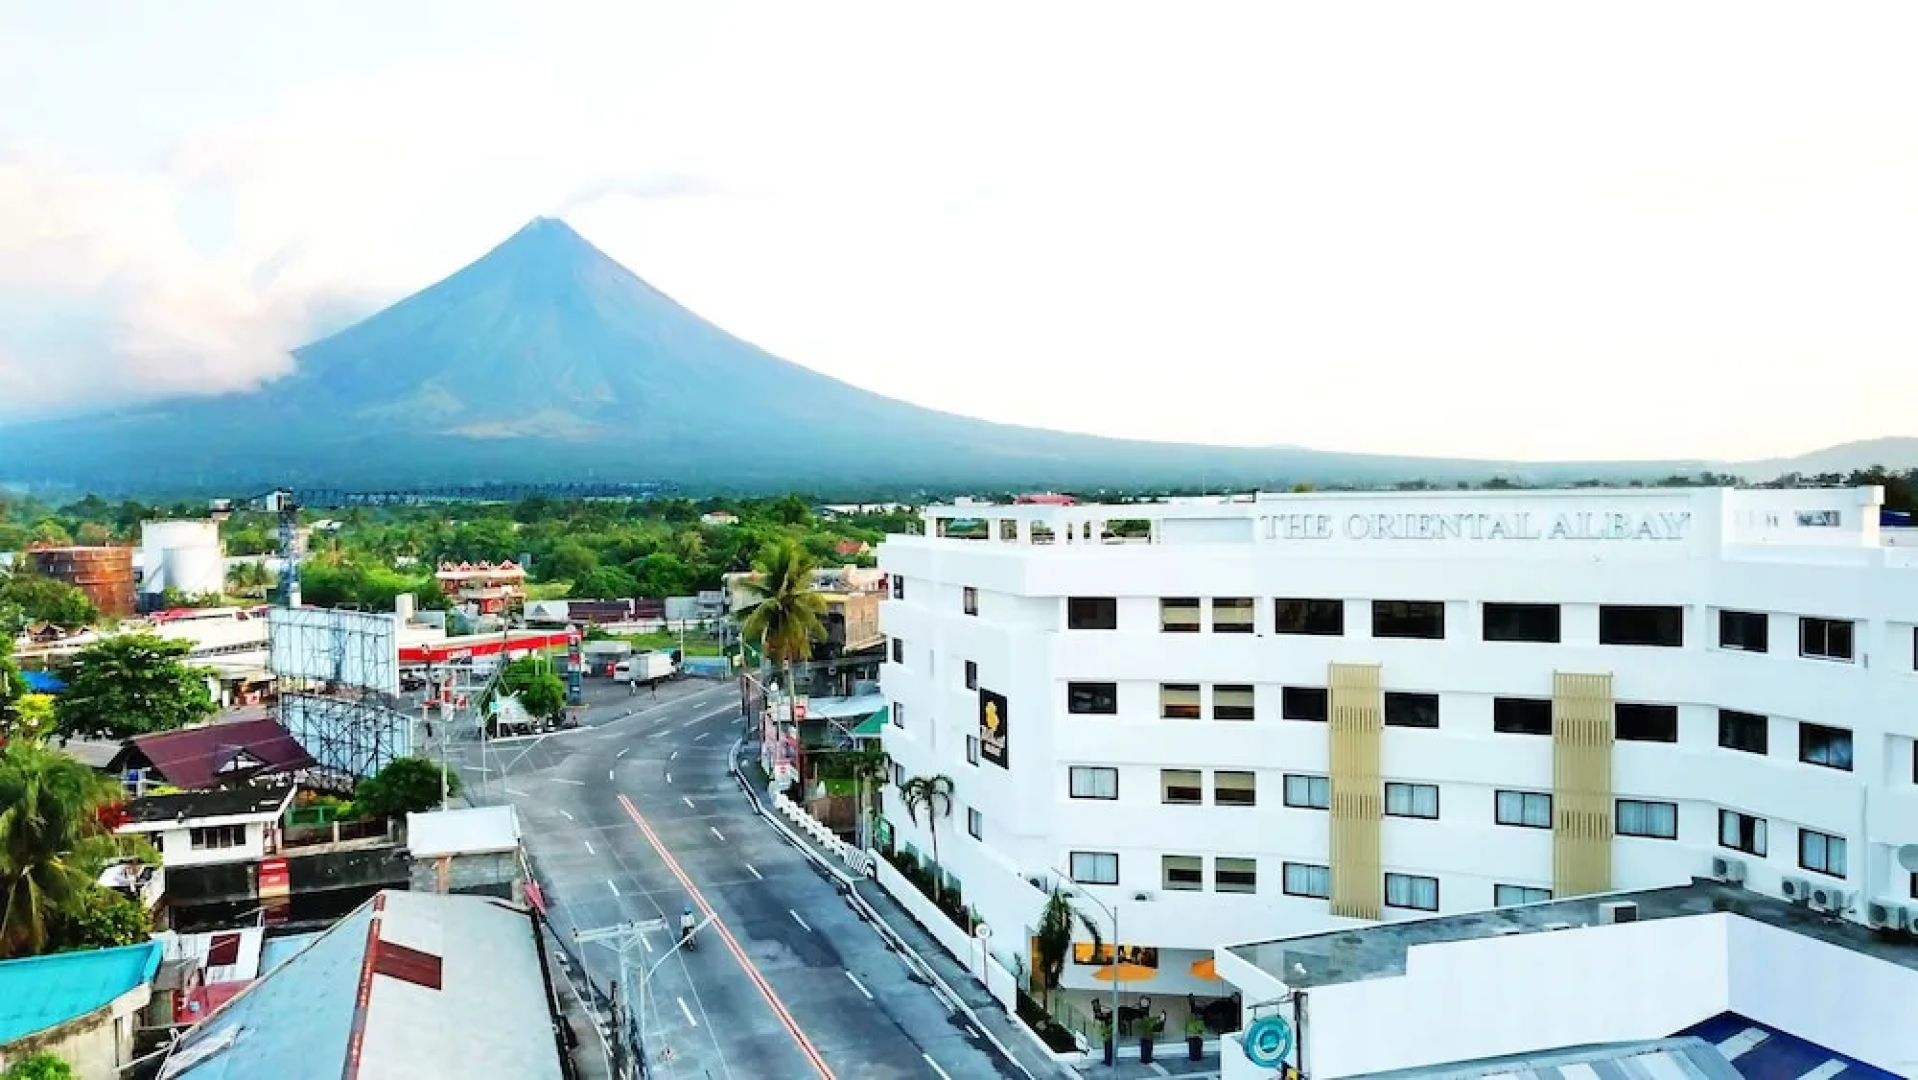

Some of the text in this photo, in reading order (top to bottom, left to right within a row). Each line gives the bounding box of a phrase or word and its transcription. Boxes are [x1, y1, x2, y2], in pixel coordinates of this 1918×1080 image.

[1260, 512, 1692, 540] THE ORIENTAL ALBAY
